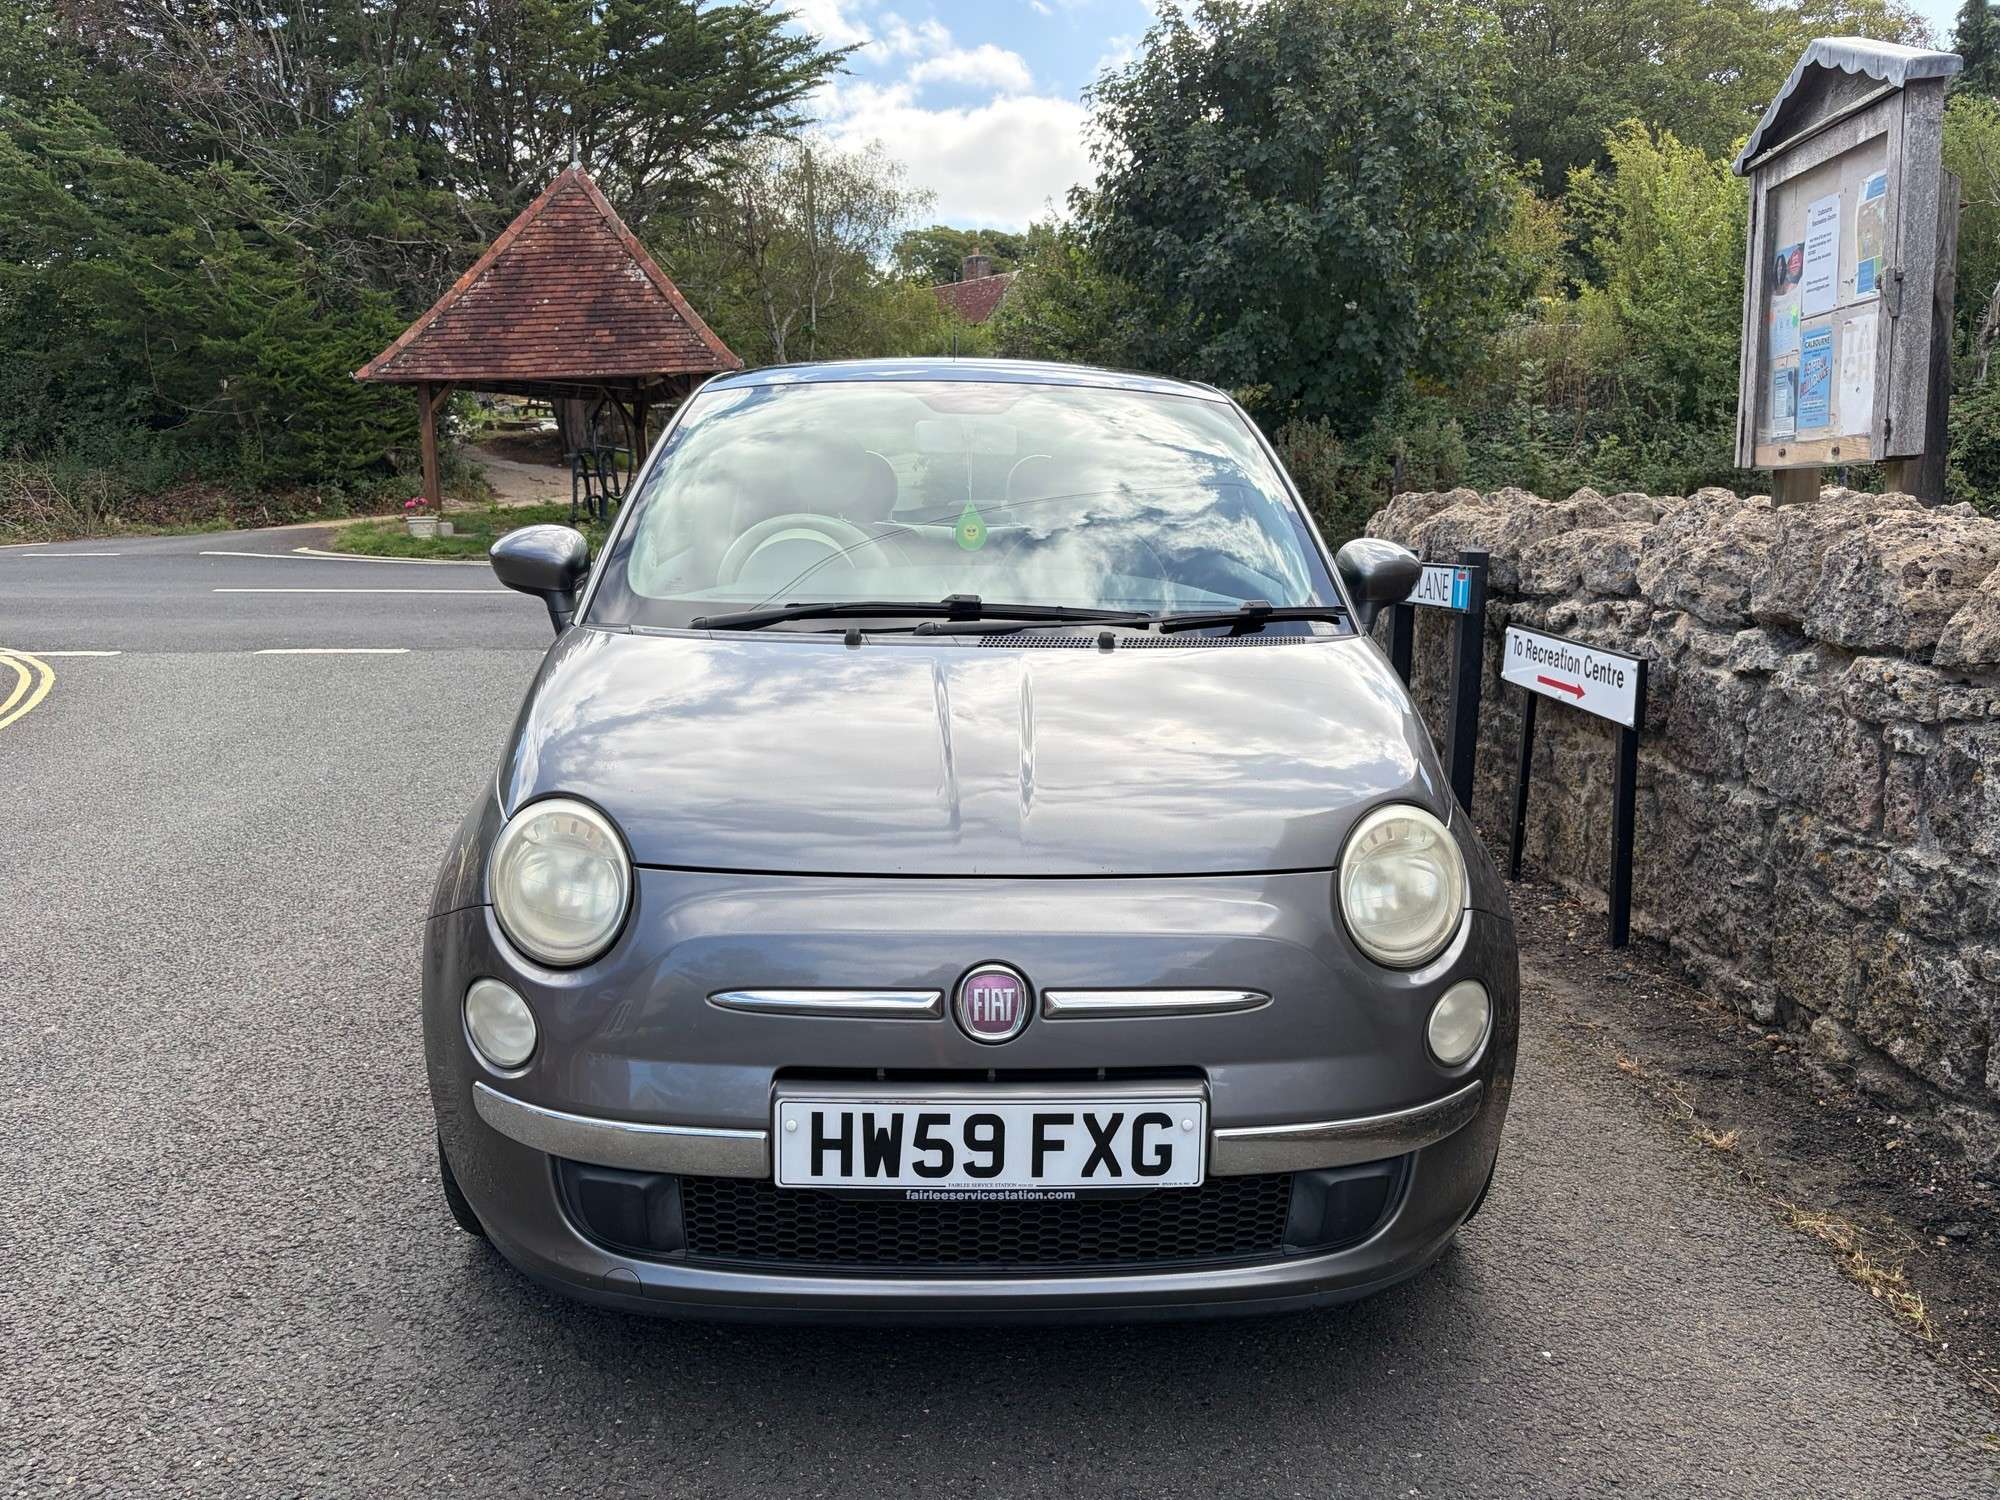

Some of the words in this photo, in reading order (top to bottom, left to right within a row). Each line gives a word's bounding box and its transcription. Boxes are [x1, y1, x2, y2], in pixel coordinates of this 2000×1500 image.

[1418, 572, 1449, 601] LANE
[1513, 634, 1523, 657] To
[1525, 638, 1581, 674] Recreation
[1583, 654, 1625, 689] Centre
[973, 987, 1015, 1022] FIAT
[810, 1112, 1006, 1178] HW59
[1031, 1112, 1174, 1178] FXG
[906, 1190, 1076, 1200] fairleeservicestation.com
